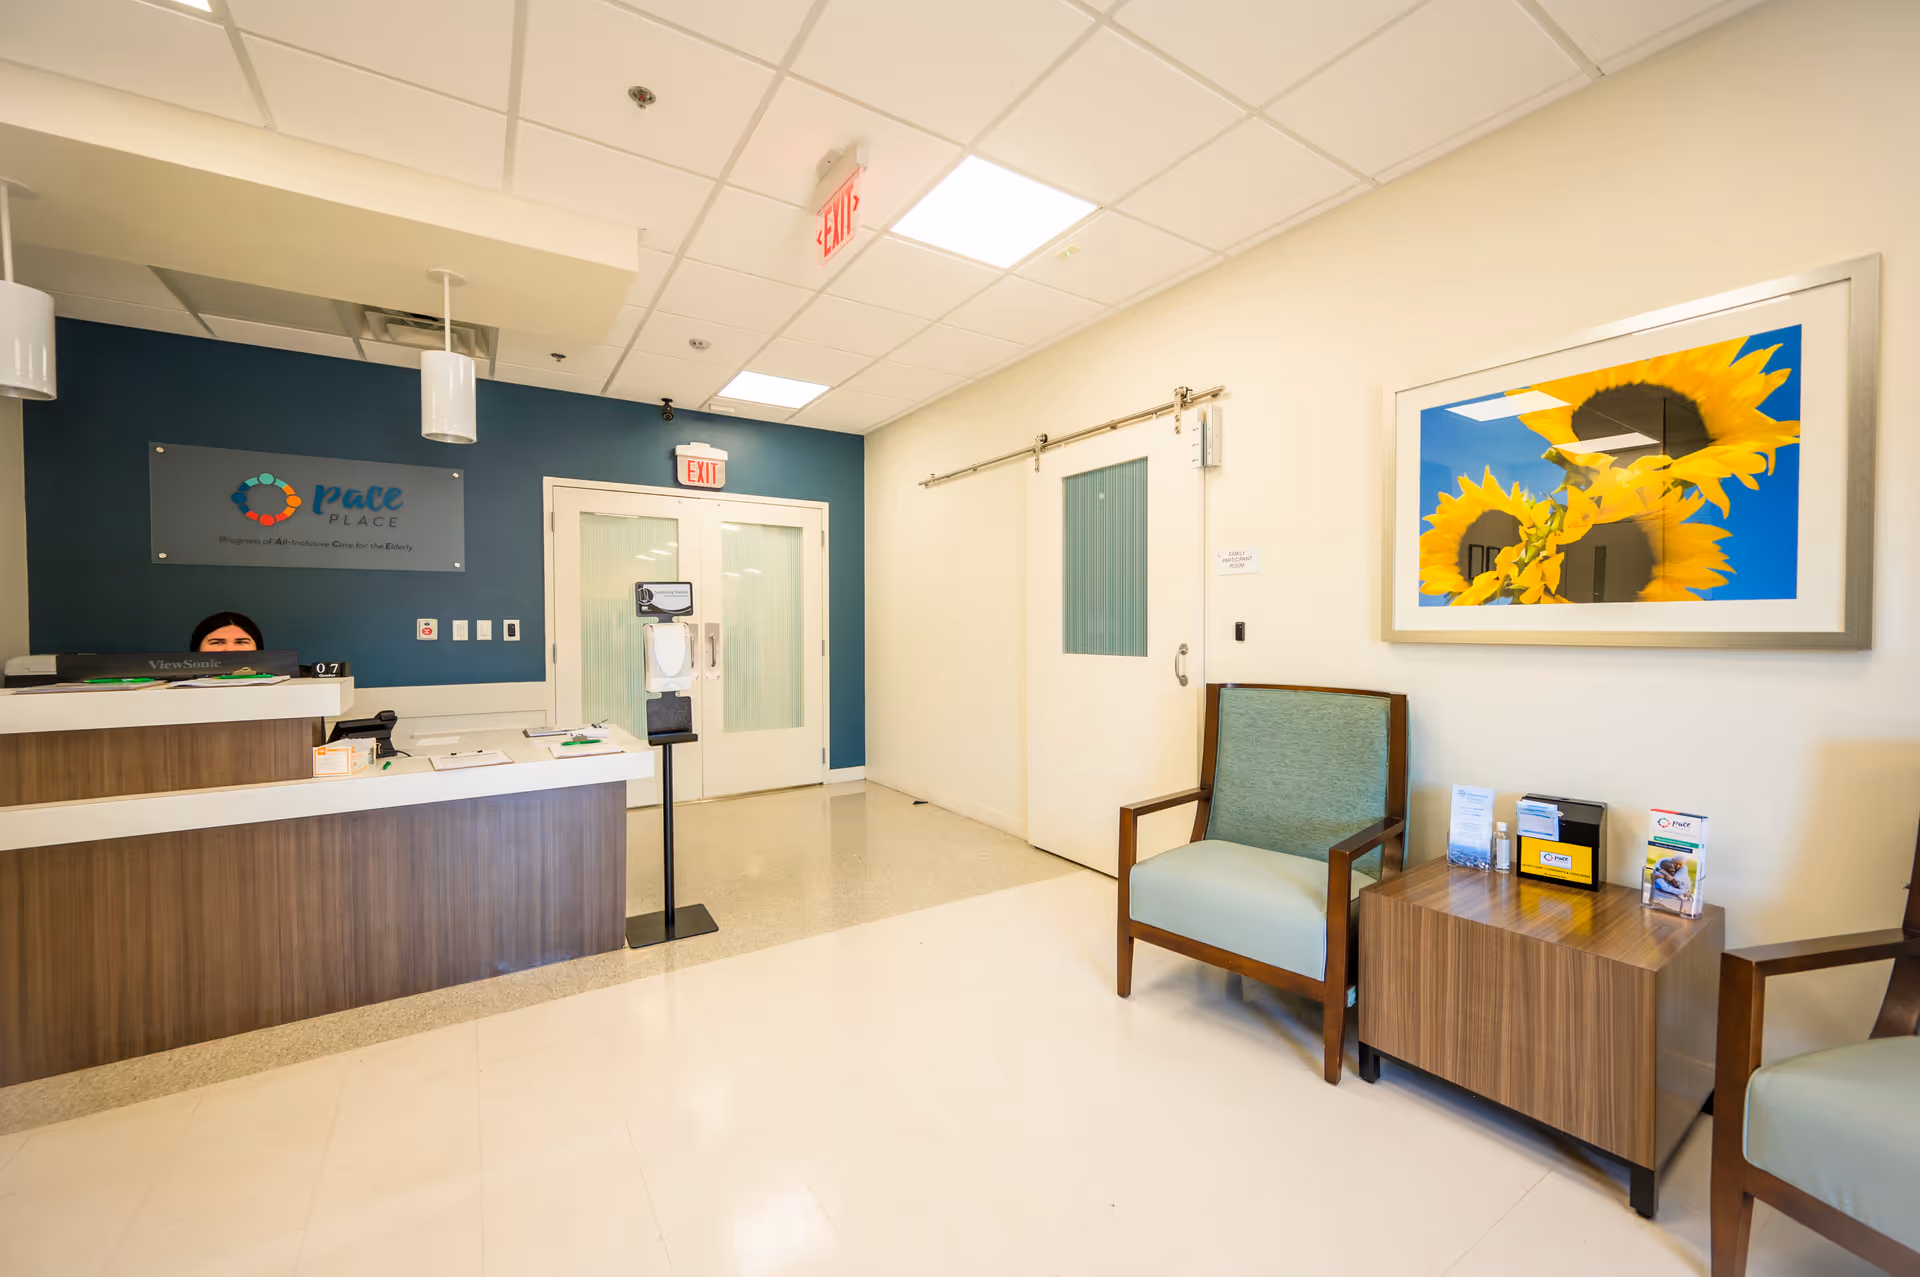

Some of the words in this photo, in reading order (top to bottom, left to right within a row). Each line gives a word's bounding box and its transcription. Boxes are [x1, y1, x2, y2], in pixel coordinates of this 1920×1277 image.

[824, 180, 854, 257] EXIT
[688, 460, 718, 484] EXIT
[313, 484, 404, 515] pace
[329, 513, 398, 528] PLACE
[263, 537, 272, 545] of
[275, 538, 330, 547] All-Inclusive
[332, 540, 353, 549] Care
[385, 542, 413, 552] Elderly
[148, 659, 222, 670] ViewSonic
